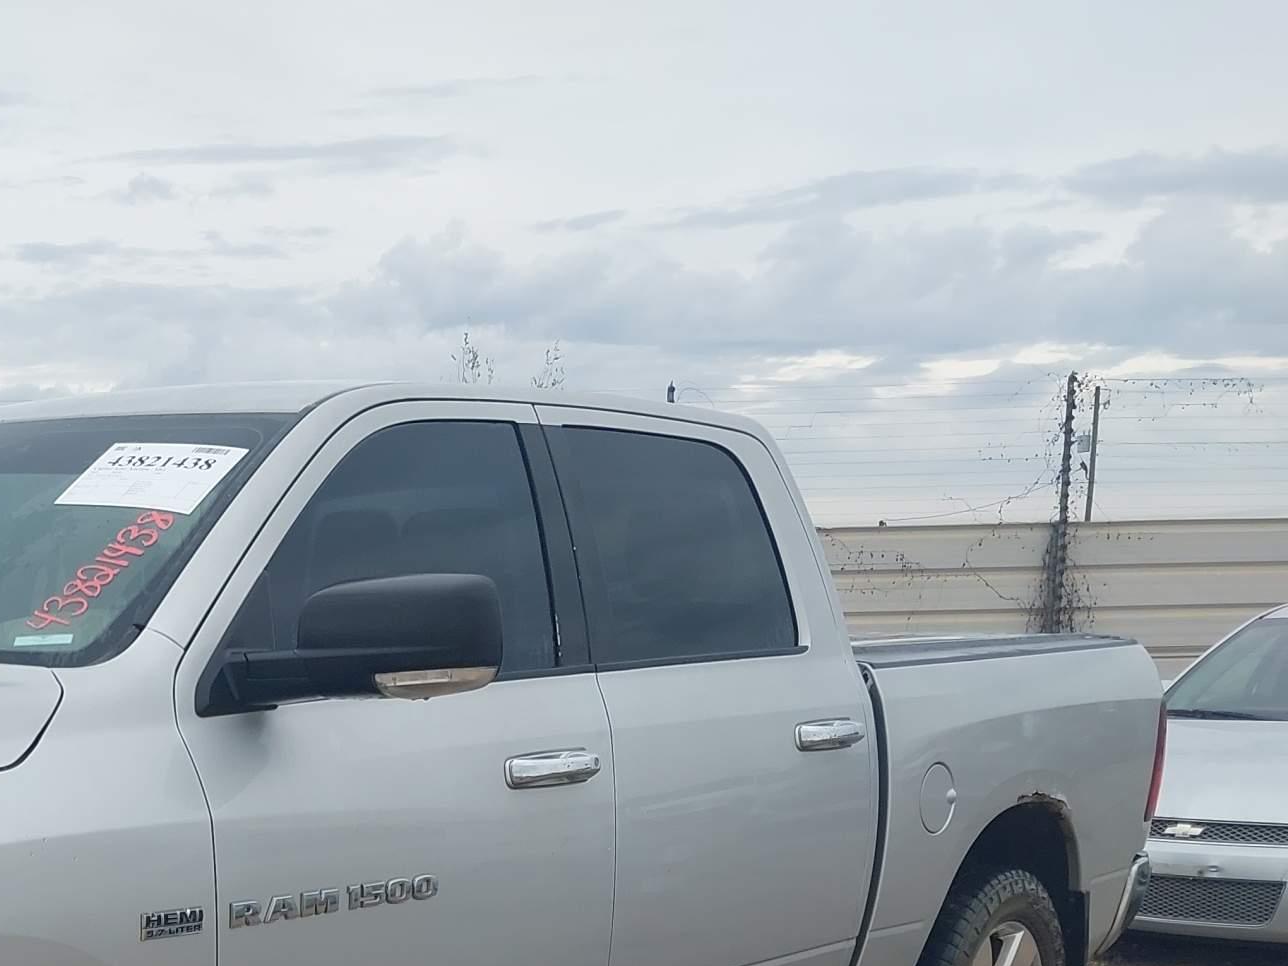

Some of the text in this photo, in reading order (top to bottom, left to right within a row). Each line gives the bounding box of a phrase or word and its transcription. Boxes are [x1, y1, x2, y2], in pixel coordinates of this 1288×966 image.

[107, 455, 217, 471] 43821438
[25, 511, 176, 630] 43821438
[143, 909, 204, 929] HEMI
[228, 873, 439, 929] RAM 1500
